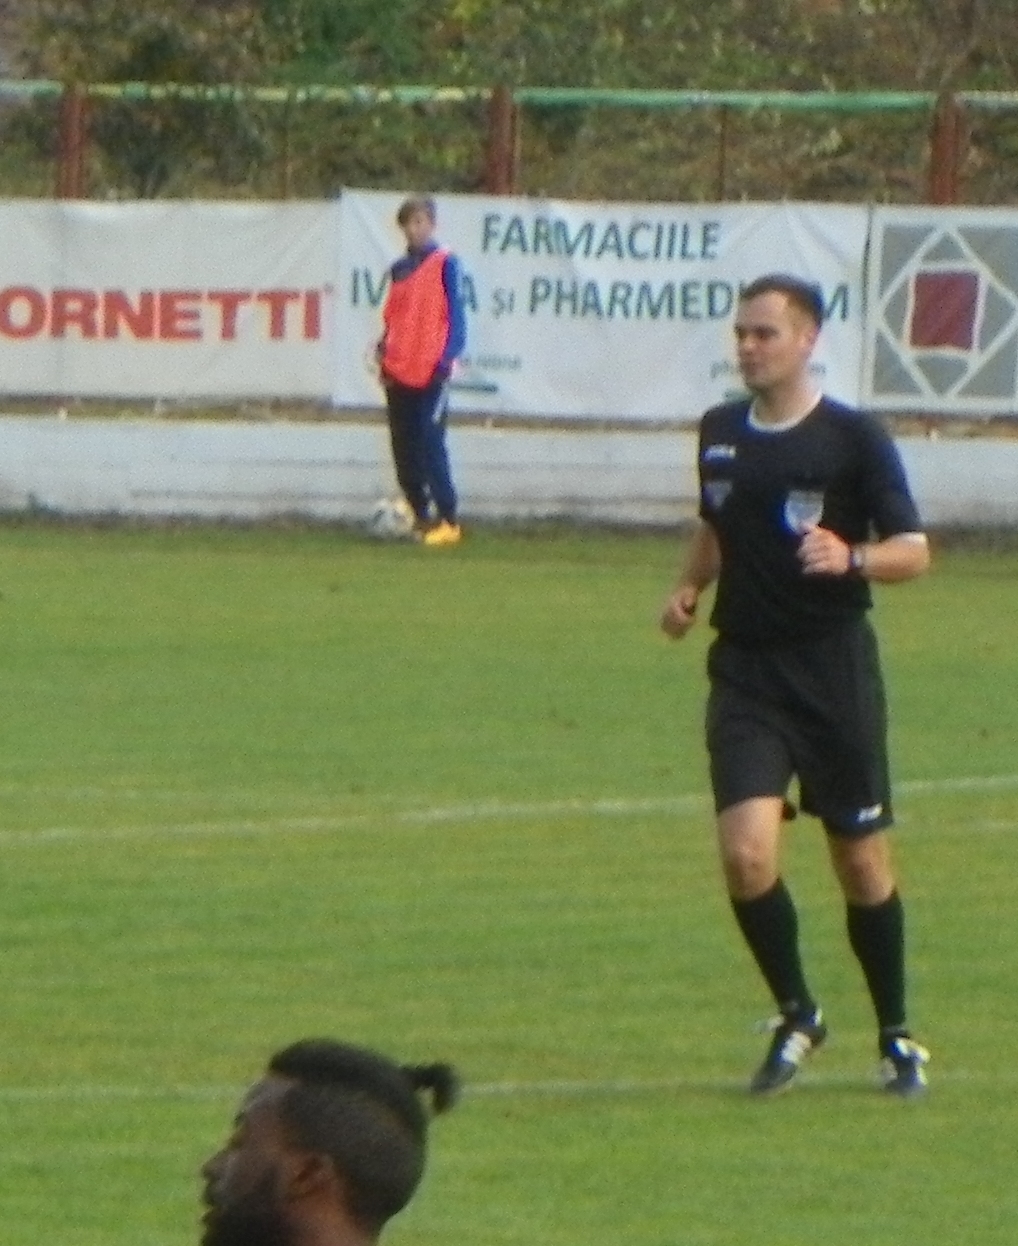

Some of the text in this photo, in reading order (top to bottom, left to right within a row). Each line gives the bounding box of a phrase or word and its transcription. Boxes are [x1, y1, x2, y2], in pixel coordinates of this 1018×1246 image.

[482, 213, 721, 261] FARMACIILE
[0, 286, 321, 341] ORNETTI
[351, 267, 477, 313] IVA
[529, 275, 850, 323] PHARMEDM
